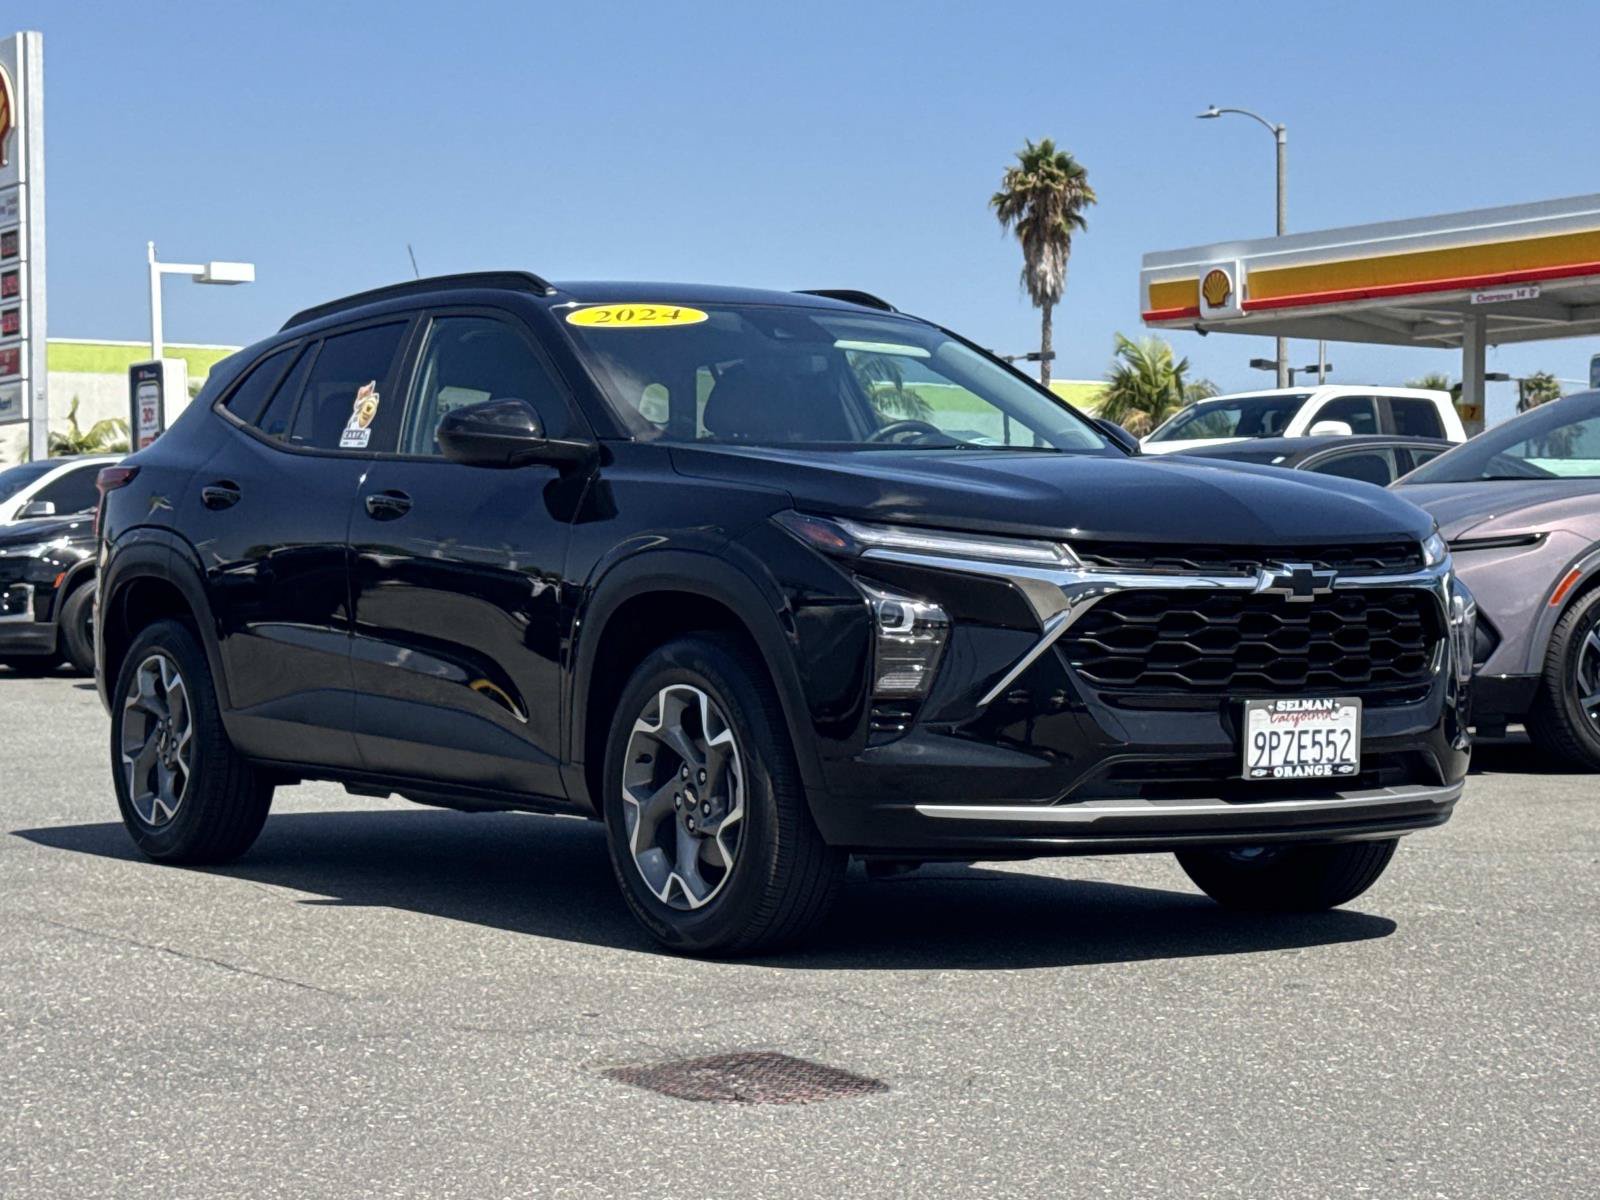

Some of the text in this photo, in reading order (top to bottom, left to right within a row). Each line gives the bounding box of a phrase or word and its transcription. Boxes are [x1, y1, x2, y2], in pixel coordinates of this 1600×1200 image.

[595, 308, 681, 323] 2024
[1276, 699, 1334, 711] SELMAN
[1270, 710, 1339, 728] California
[1254, 728, 1352, 766] 9PZE552
[1273, 764, 1333, 777] ORANGE
